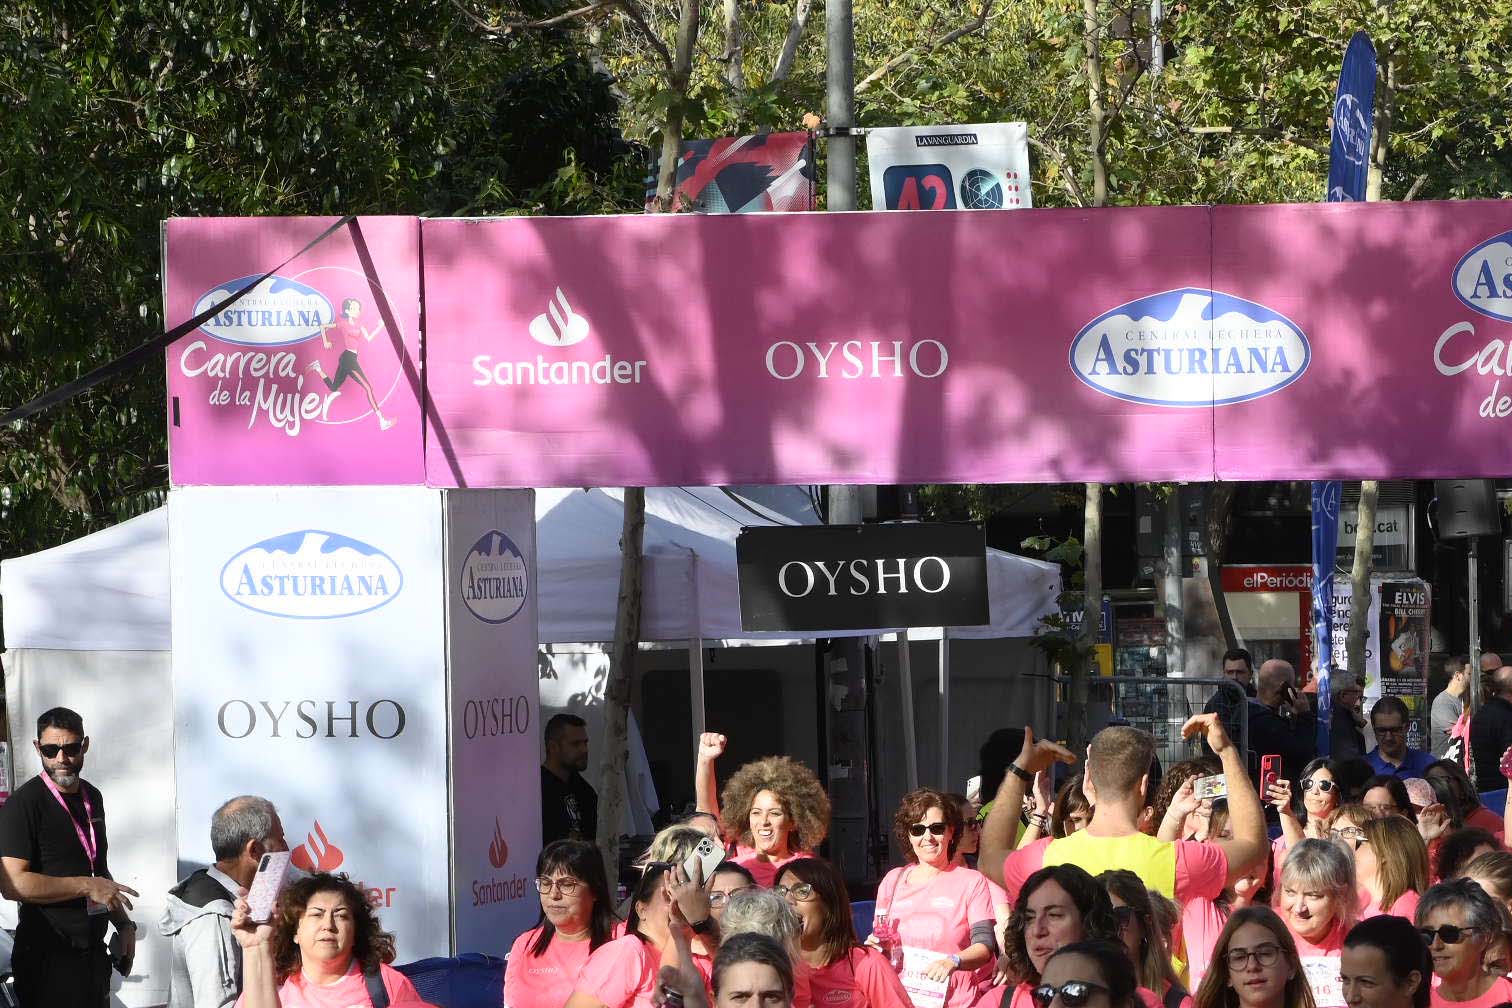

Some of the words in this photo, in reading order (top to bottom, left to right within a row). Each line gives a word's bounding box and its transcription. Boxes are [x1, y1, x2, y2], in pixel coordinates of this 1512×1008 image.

[205, 301, 323, 328] ASTURIANA
[180, 341, 297, 378] Carrera
[472, 354, 647, 386] Santander
[765, 339, 949, 380] OYSHO
[1087, 332, 1293, 377] ASTURIANA
[209, 380, 230, 406] de
[235, 379, 251, 406] la
[248, 373, 341, 437] Mujer
[235, 563, 390, 598] ASTURIANA
[466, 566, 525, 601] ASTURIANA
[778, 556, 951, 598] OYSHO
[1394, 591, 1426, 605] ELVIS
[217, 699, 407, 740] OYSHO
[463, 695, 530, 740] OYSHO
[472, 874, 529, 907] Santander
